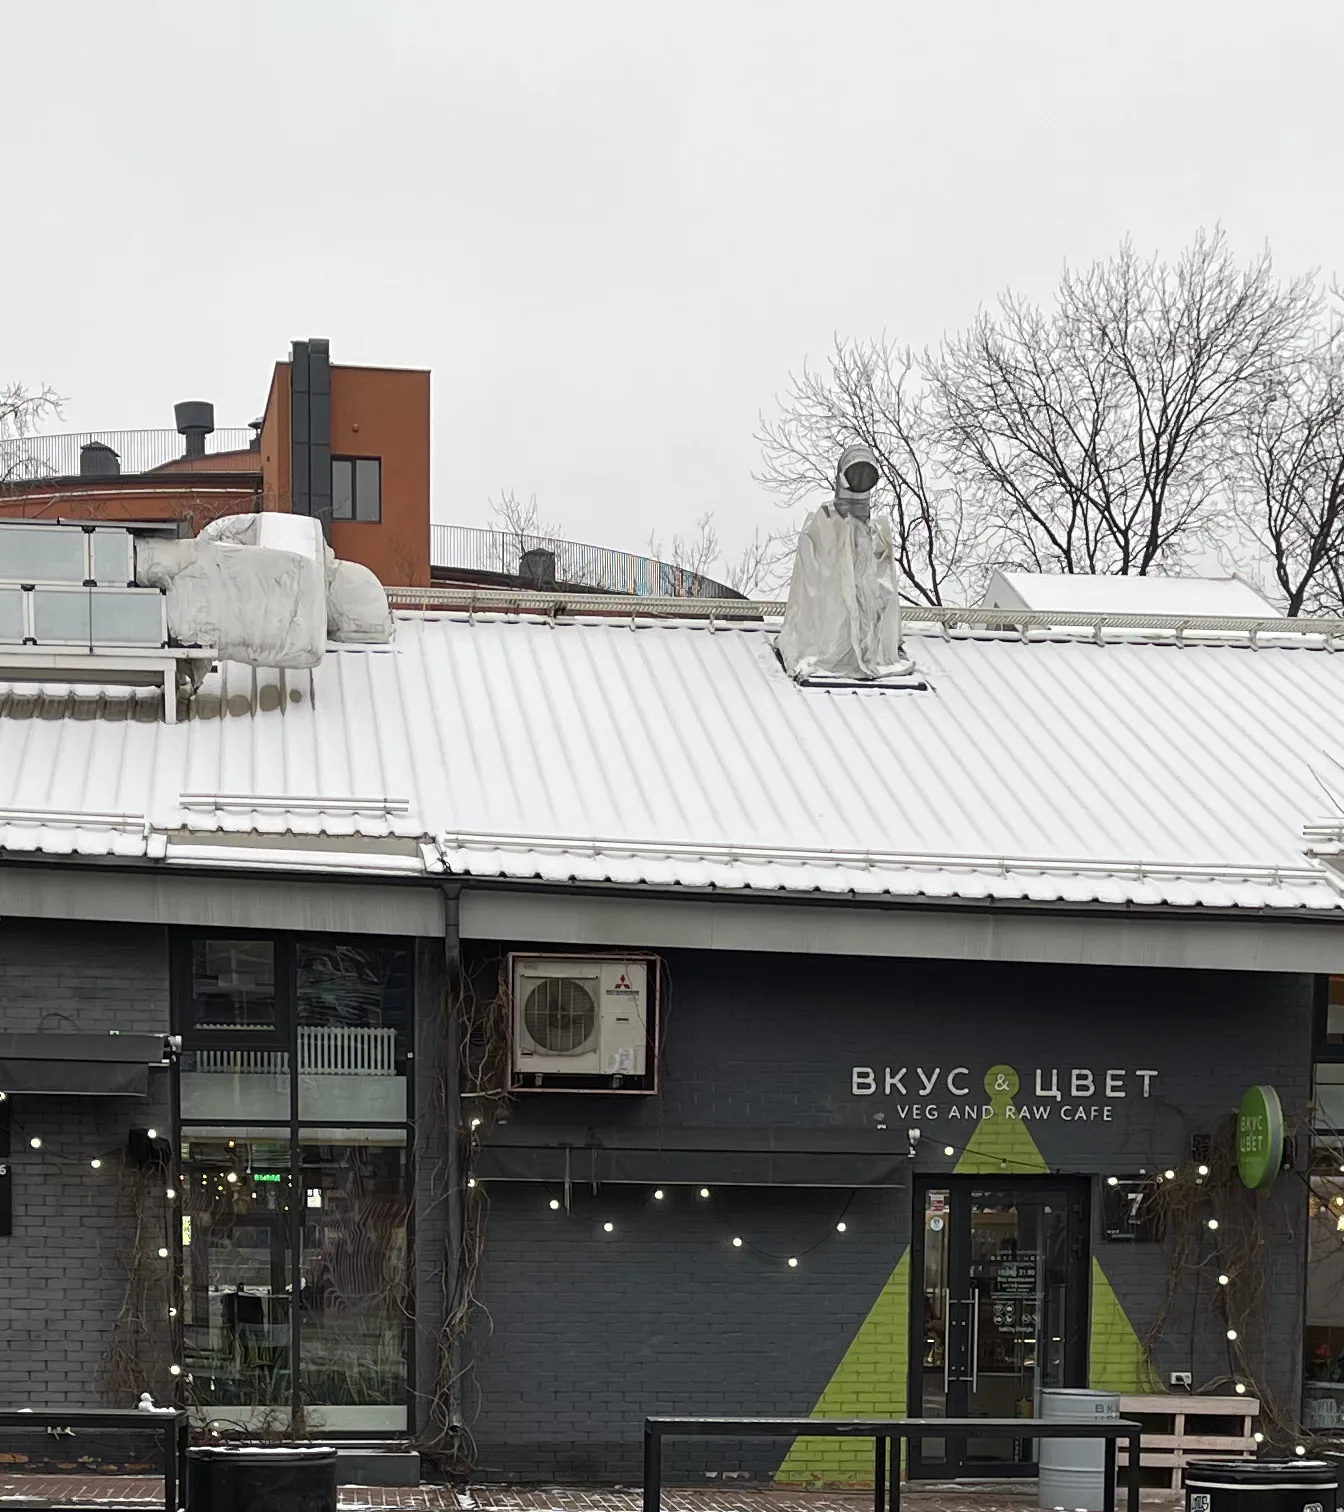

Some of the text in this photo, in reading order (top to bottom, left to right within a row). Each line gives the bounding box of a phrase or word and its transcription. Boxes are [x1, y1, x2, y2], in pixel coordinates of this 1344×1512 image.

[852, 1067, 1159, 1101] ВКУС & ЦВЕТ
[897, 1104, 1113, 1121] VEG AND RAW CAFE
[1240, 1115, 1263, 1132] ВКУС
[1240, 1135, 1263, 1153] ЦВЕТ
[1127, 1192, 1144, 1216] 7
